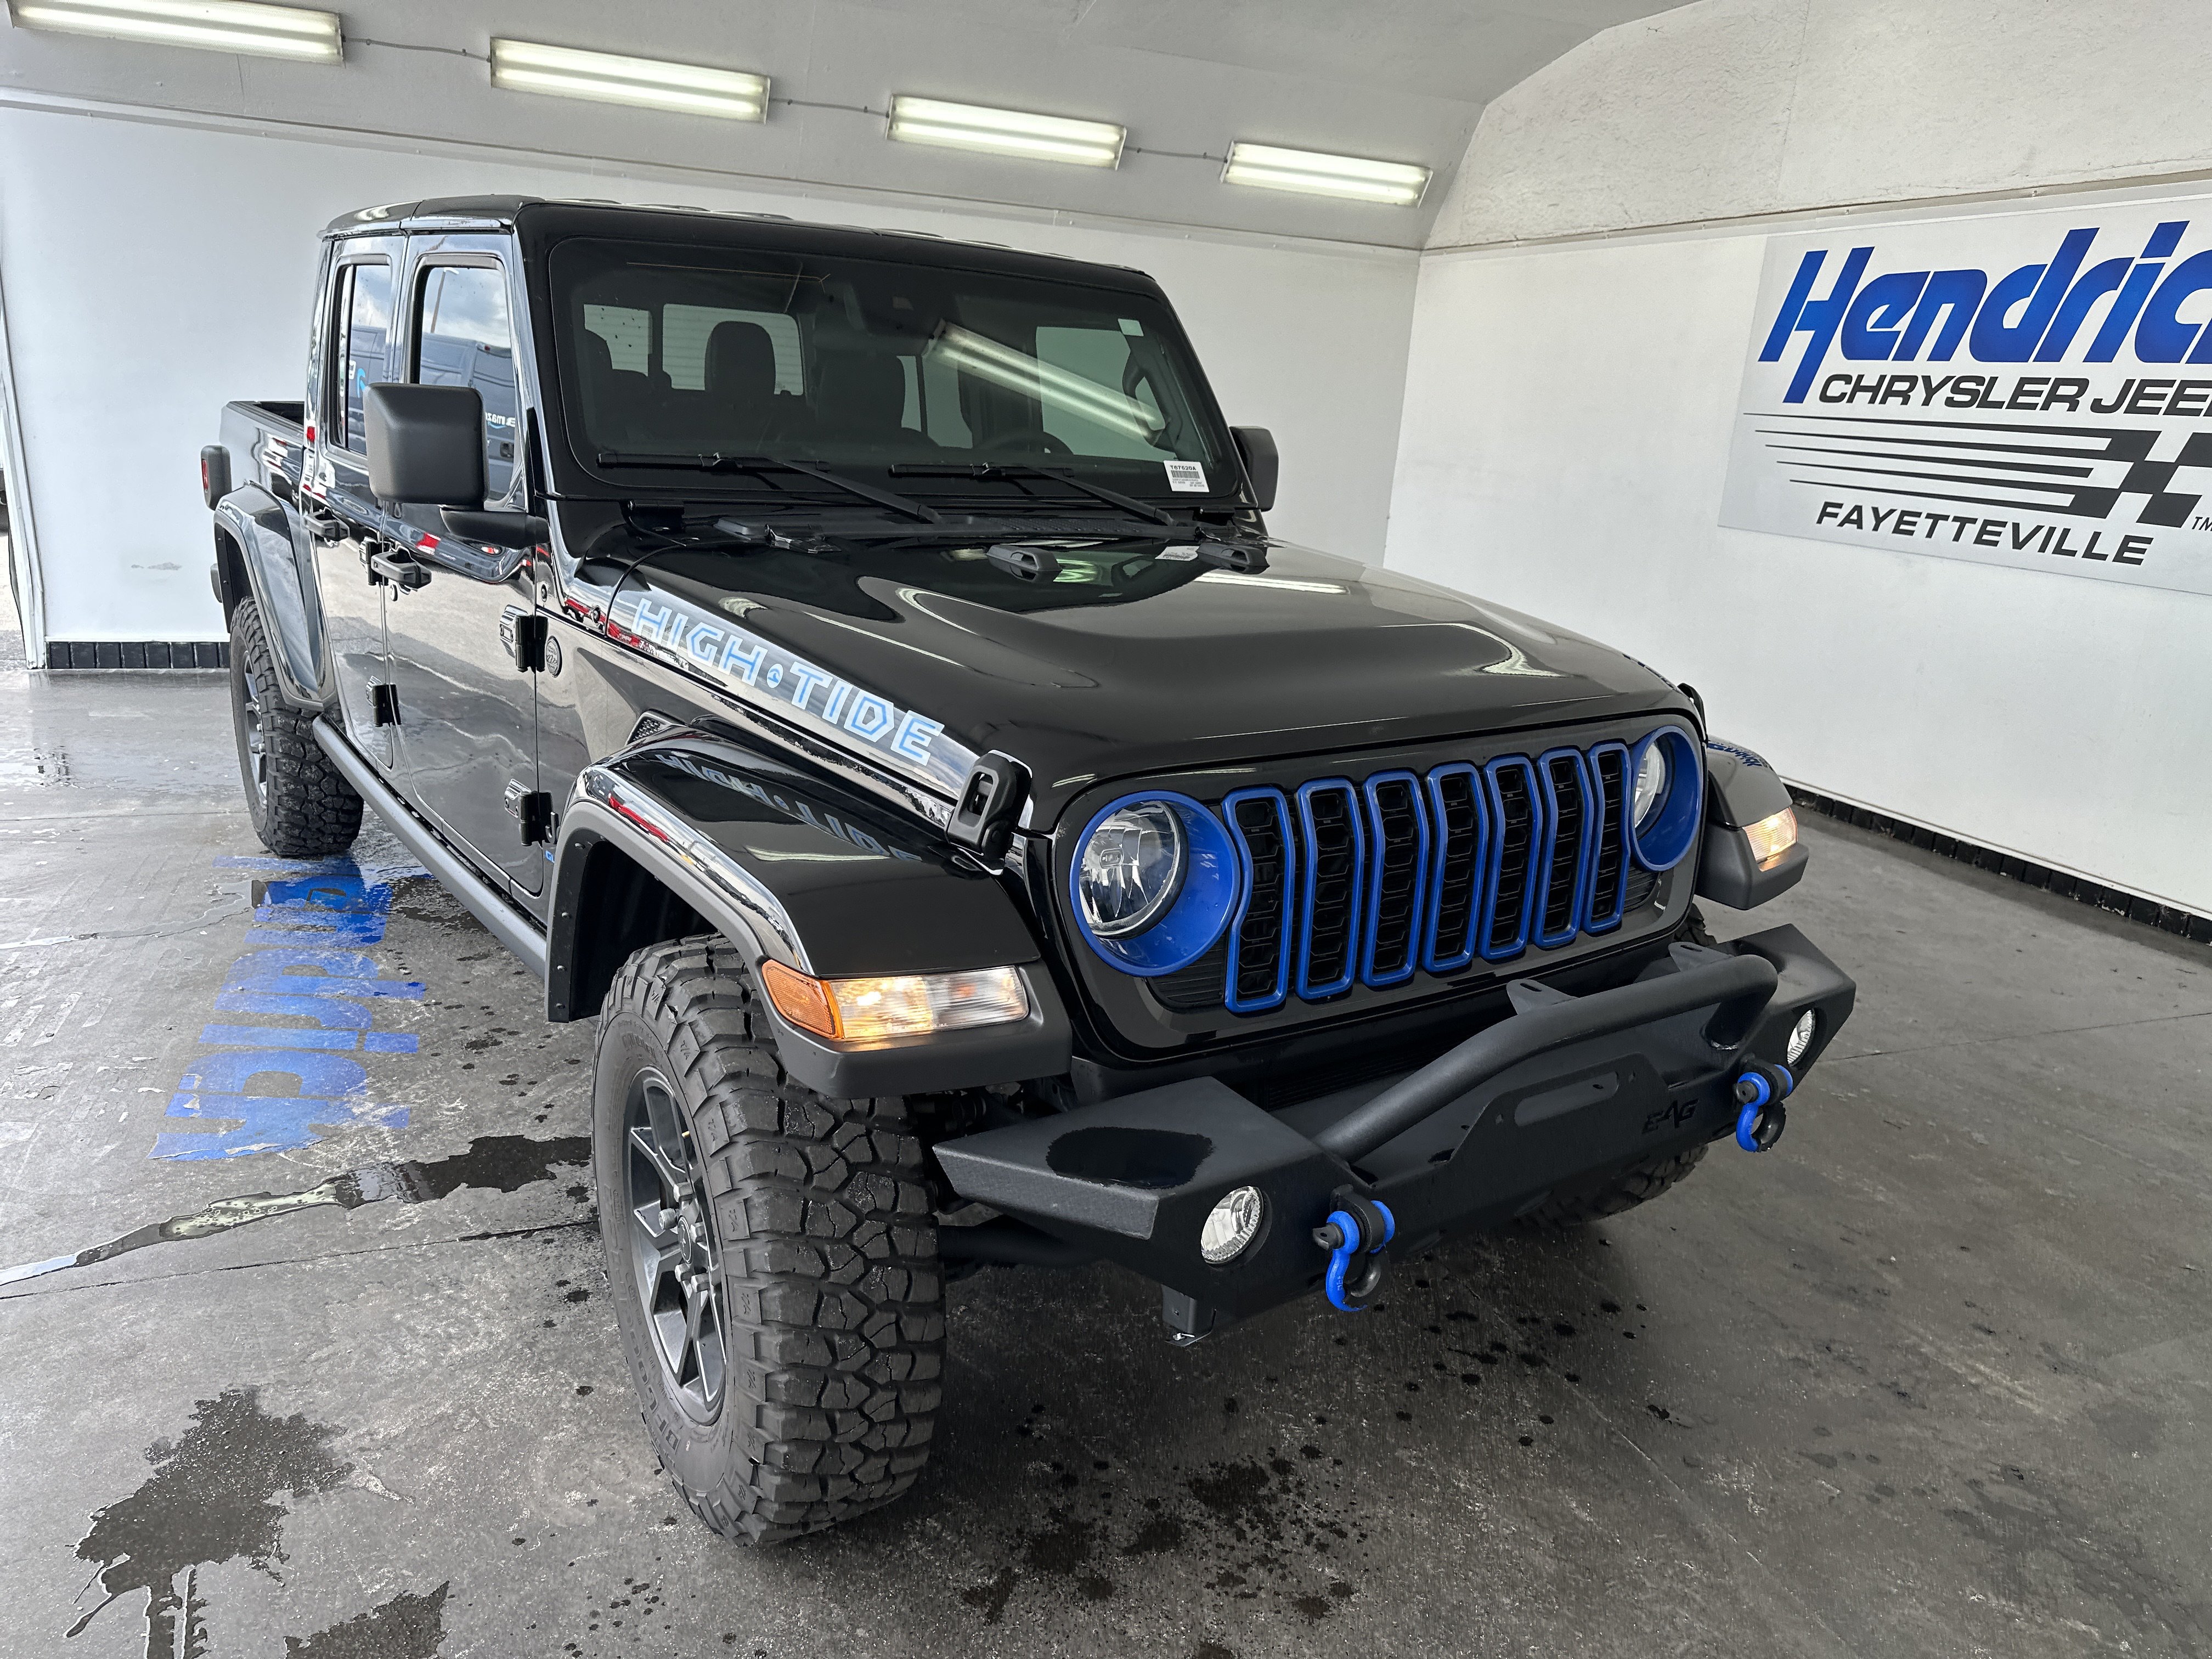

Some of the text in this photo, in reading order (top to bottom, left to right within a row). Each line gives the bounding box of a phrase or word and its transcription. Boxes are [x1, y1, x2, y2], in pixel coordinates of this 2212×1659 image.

[1758, 220, 2212, 403] Hendric
[1819, 374, 2212, 417] CHRYSLER JEE
[1816, 501, 2154, 566] FAYETTEVILLE
[631, 597, 945, 766] HIGH TIDE
